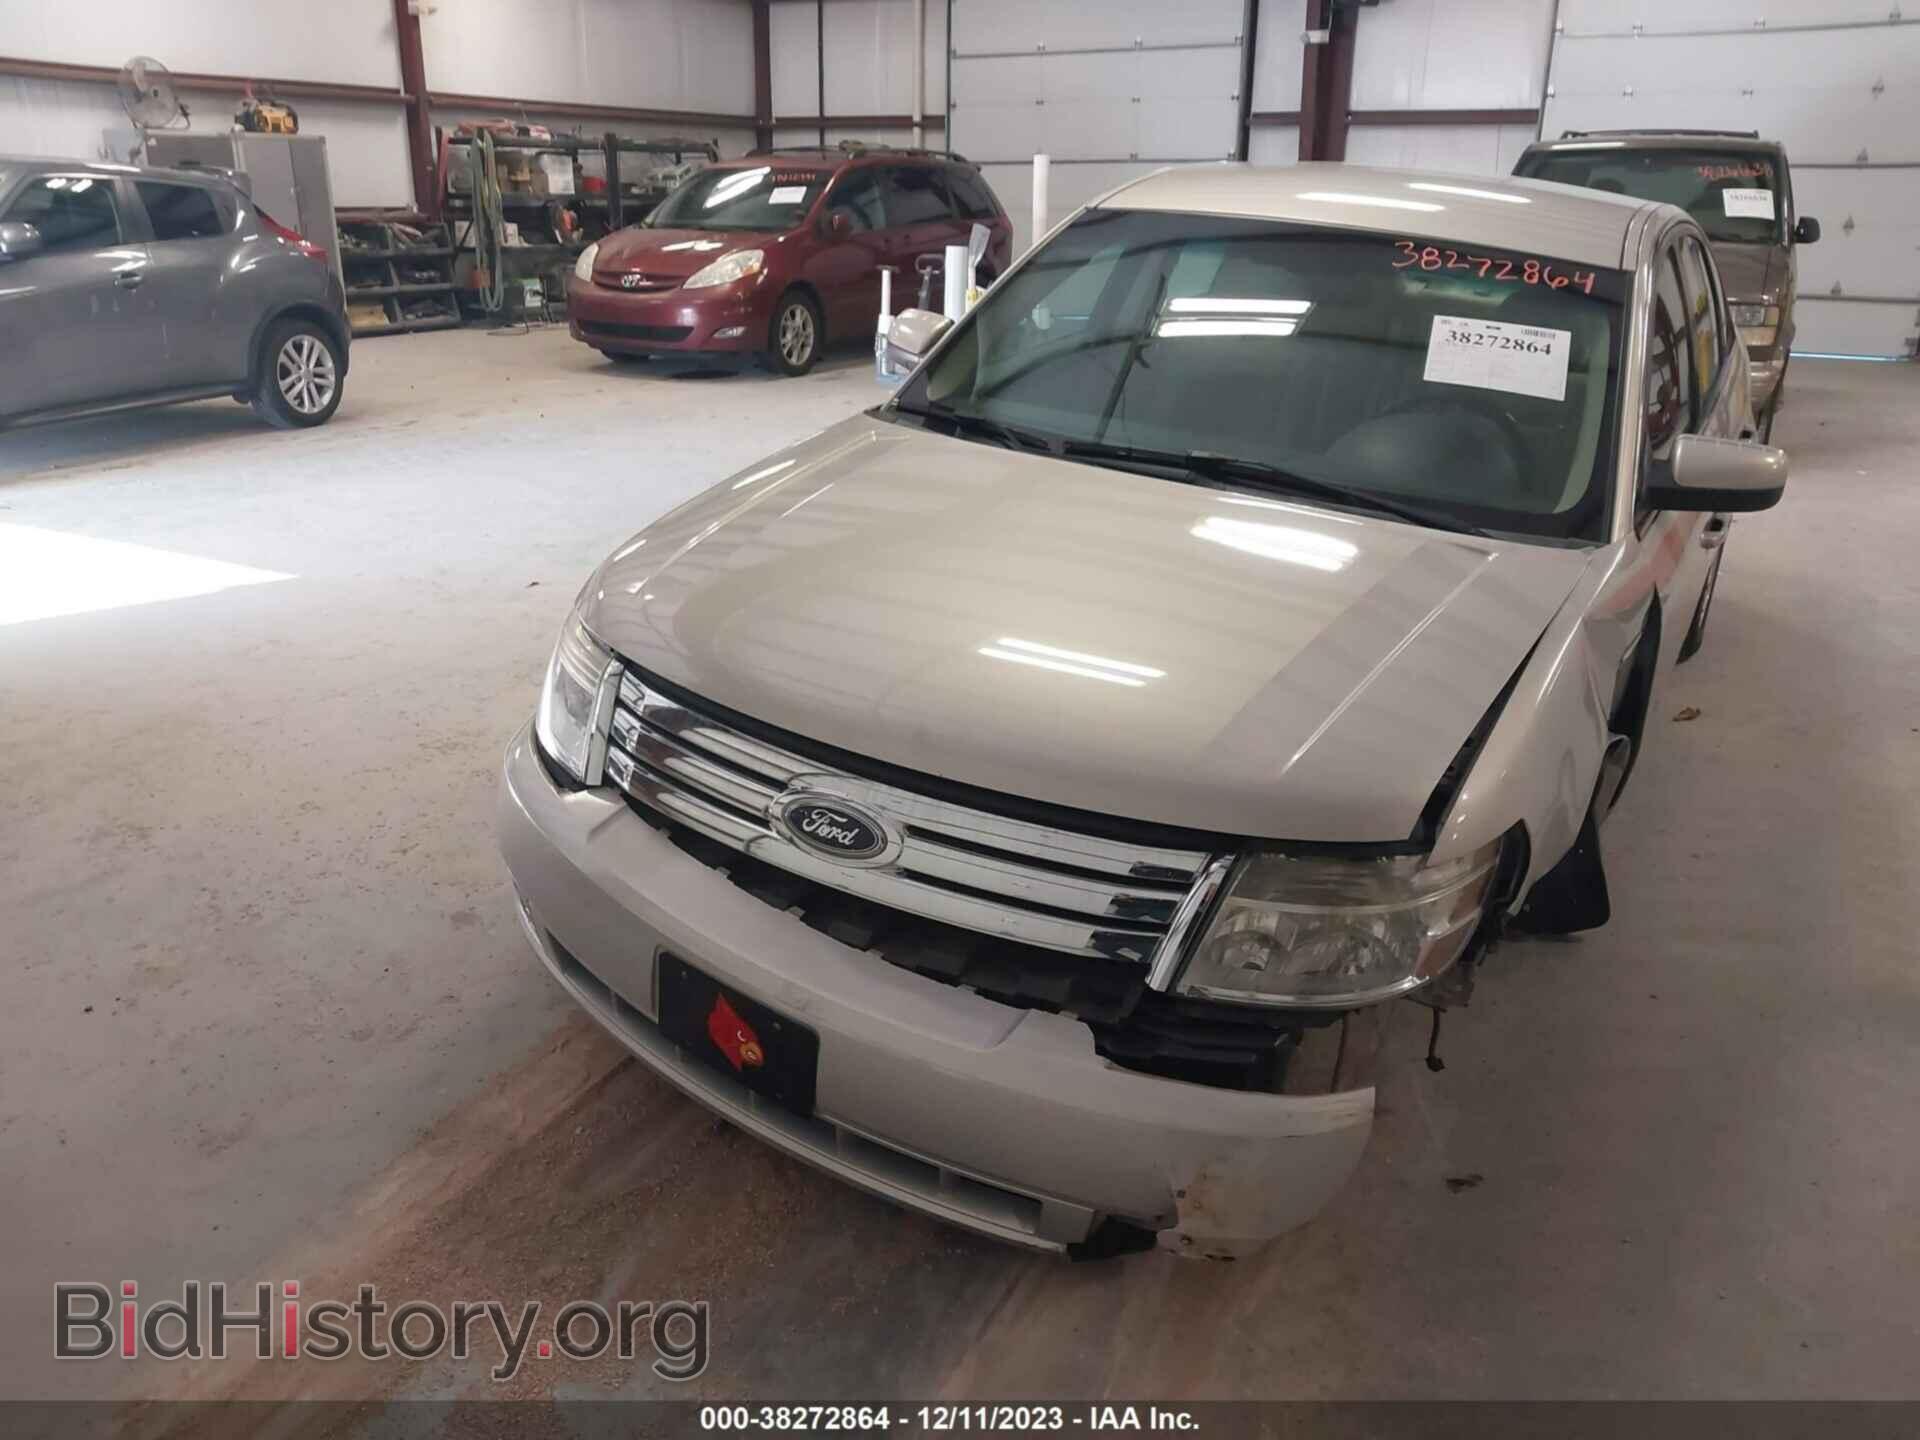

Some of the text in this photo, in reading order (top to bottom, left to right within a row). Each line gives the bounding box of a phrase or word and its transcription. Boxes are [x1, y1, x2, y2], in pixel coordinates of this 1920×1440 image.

[1392, 241, 1596, 295] 38272864
[1445, 329, 1552, 355] 38272864
[802, 808, 860, 845] Ford
